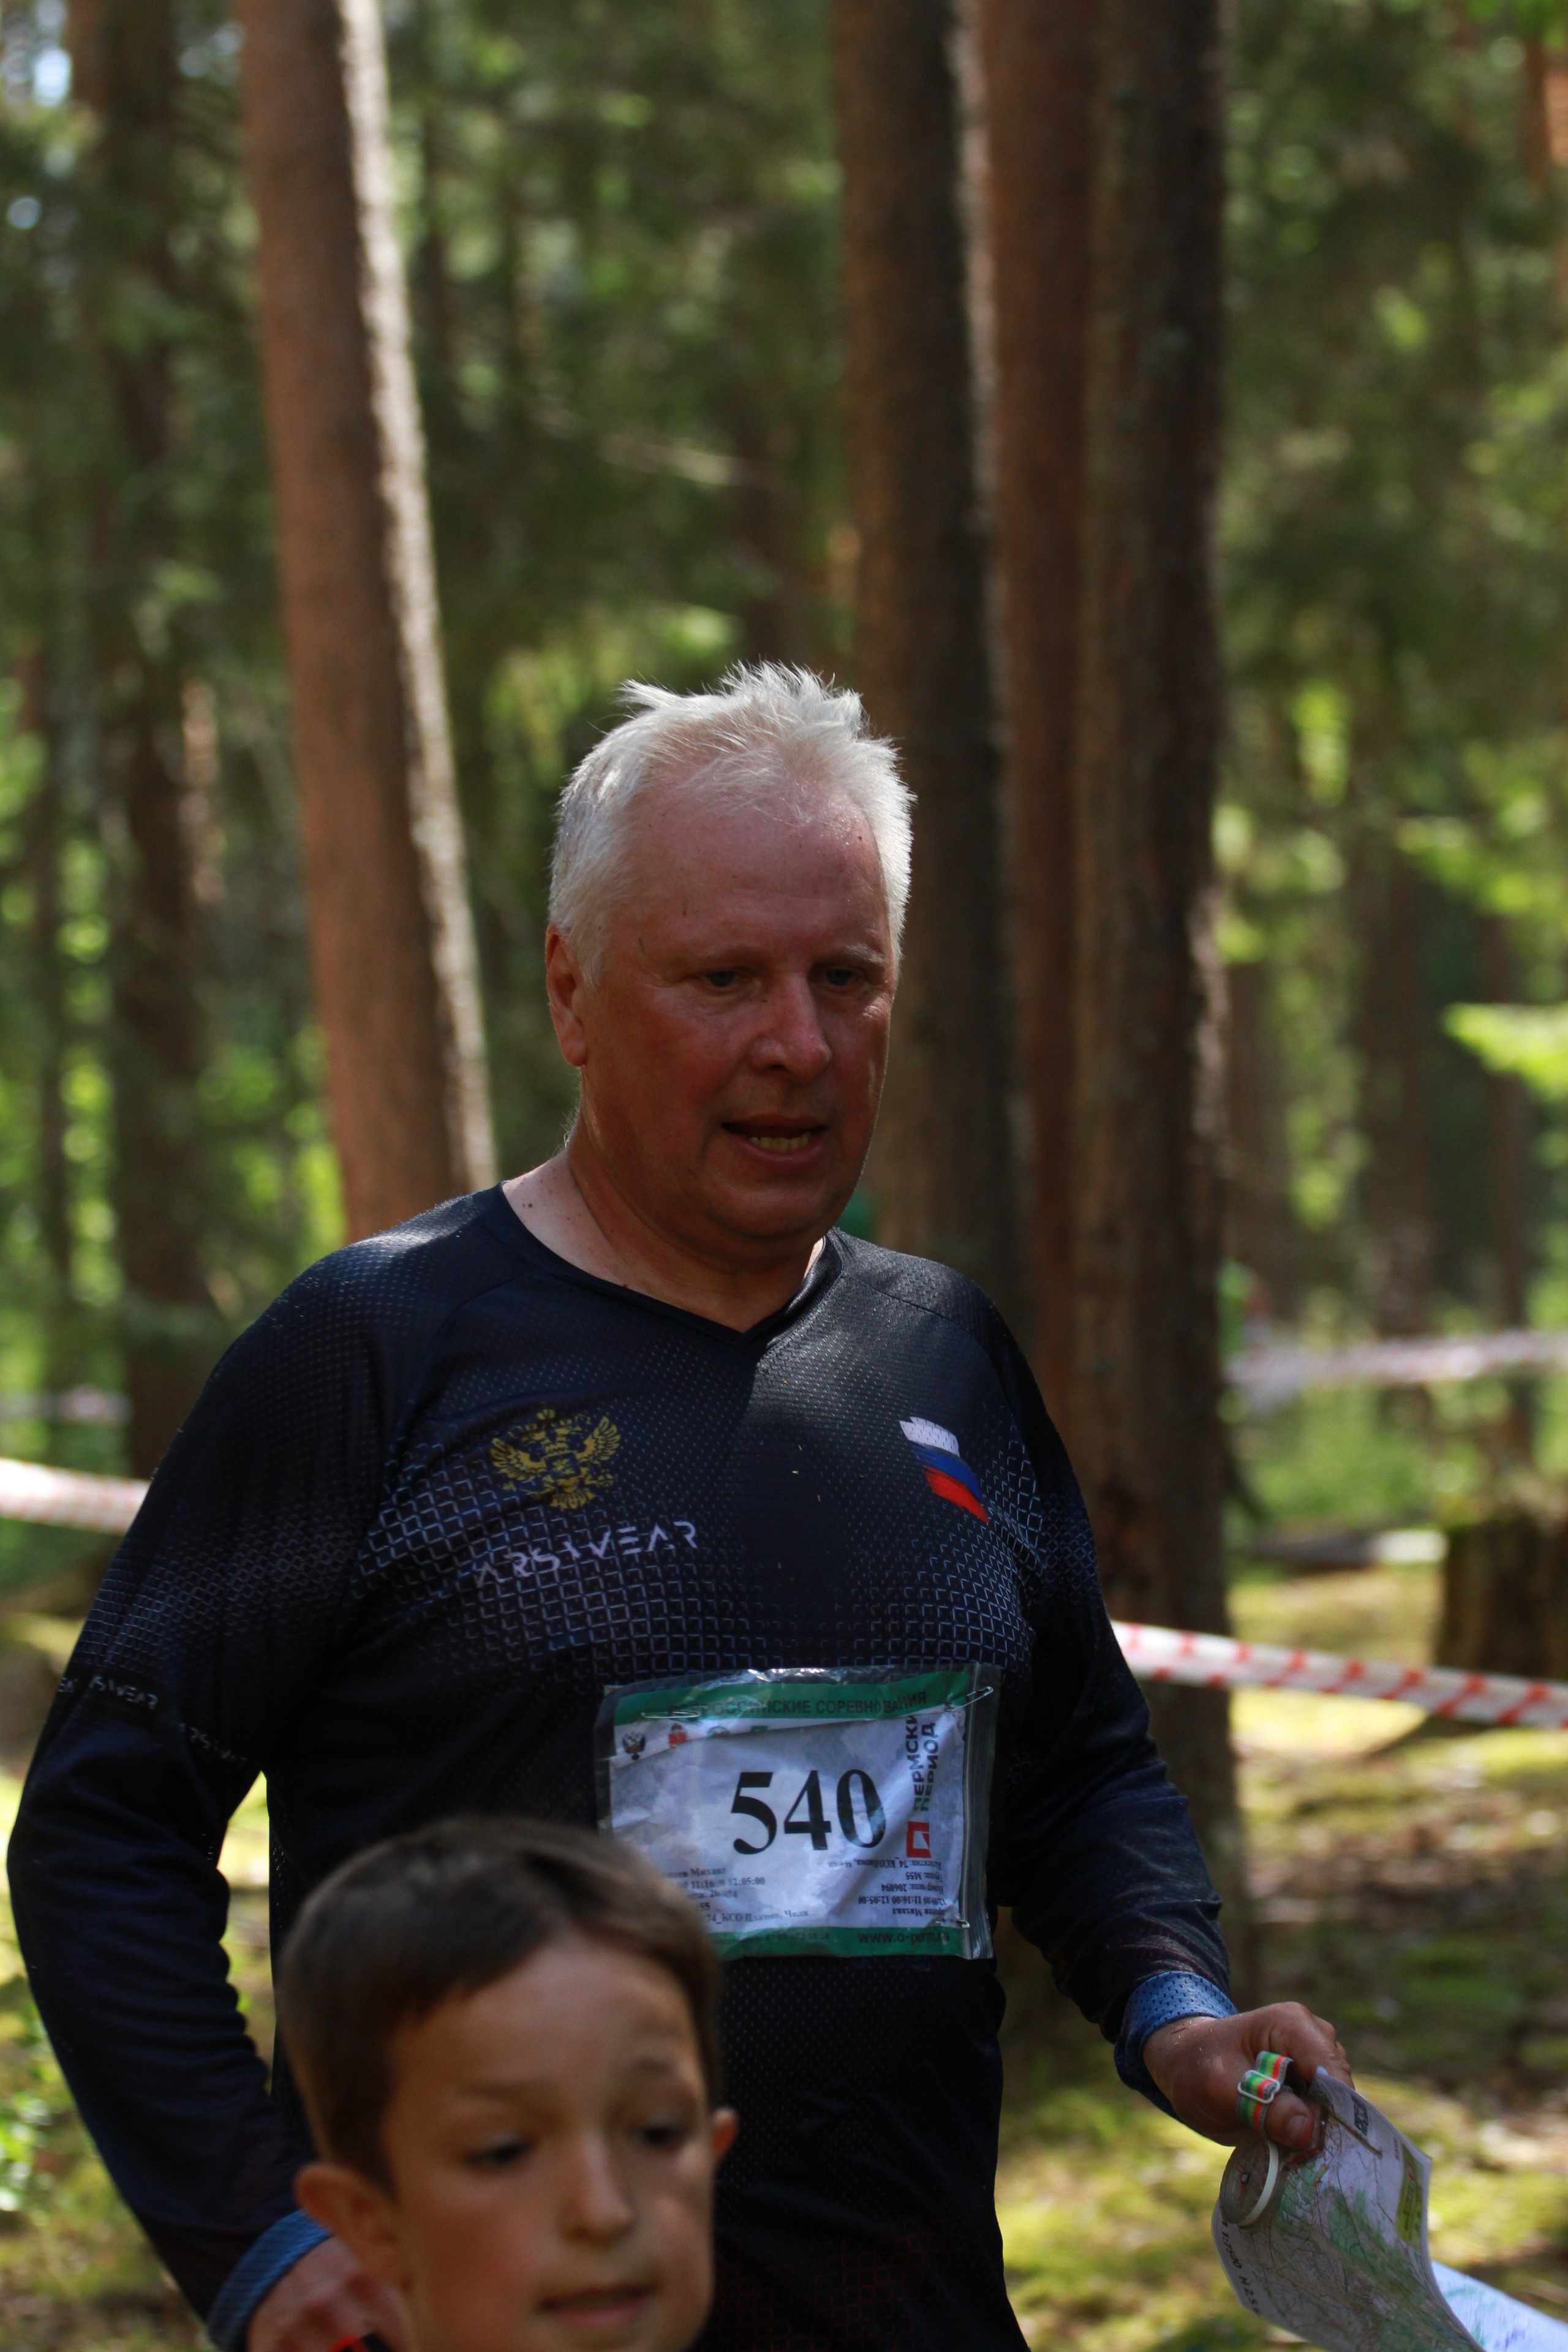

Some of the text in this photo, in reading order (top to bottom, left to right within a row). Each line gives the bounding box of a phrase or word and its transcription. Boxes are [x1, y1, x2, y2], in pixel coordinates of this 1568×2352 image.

[815, 1691, 927, 1714] СОРЕВНОВАНИЯ
[920, 1722, 939, 1812] ПЕРИОД
[730, 1768, 887, 1855] 540
[881, 1883, 907, 1892] 206894
[892, 1908, 923, 1917] Михаил
